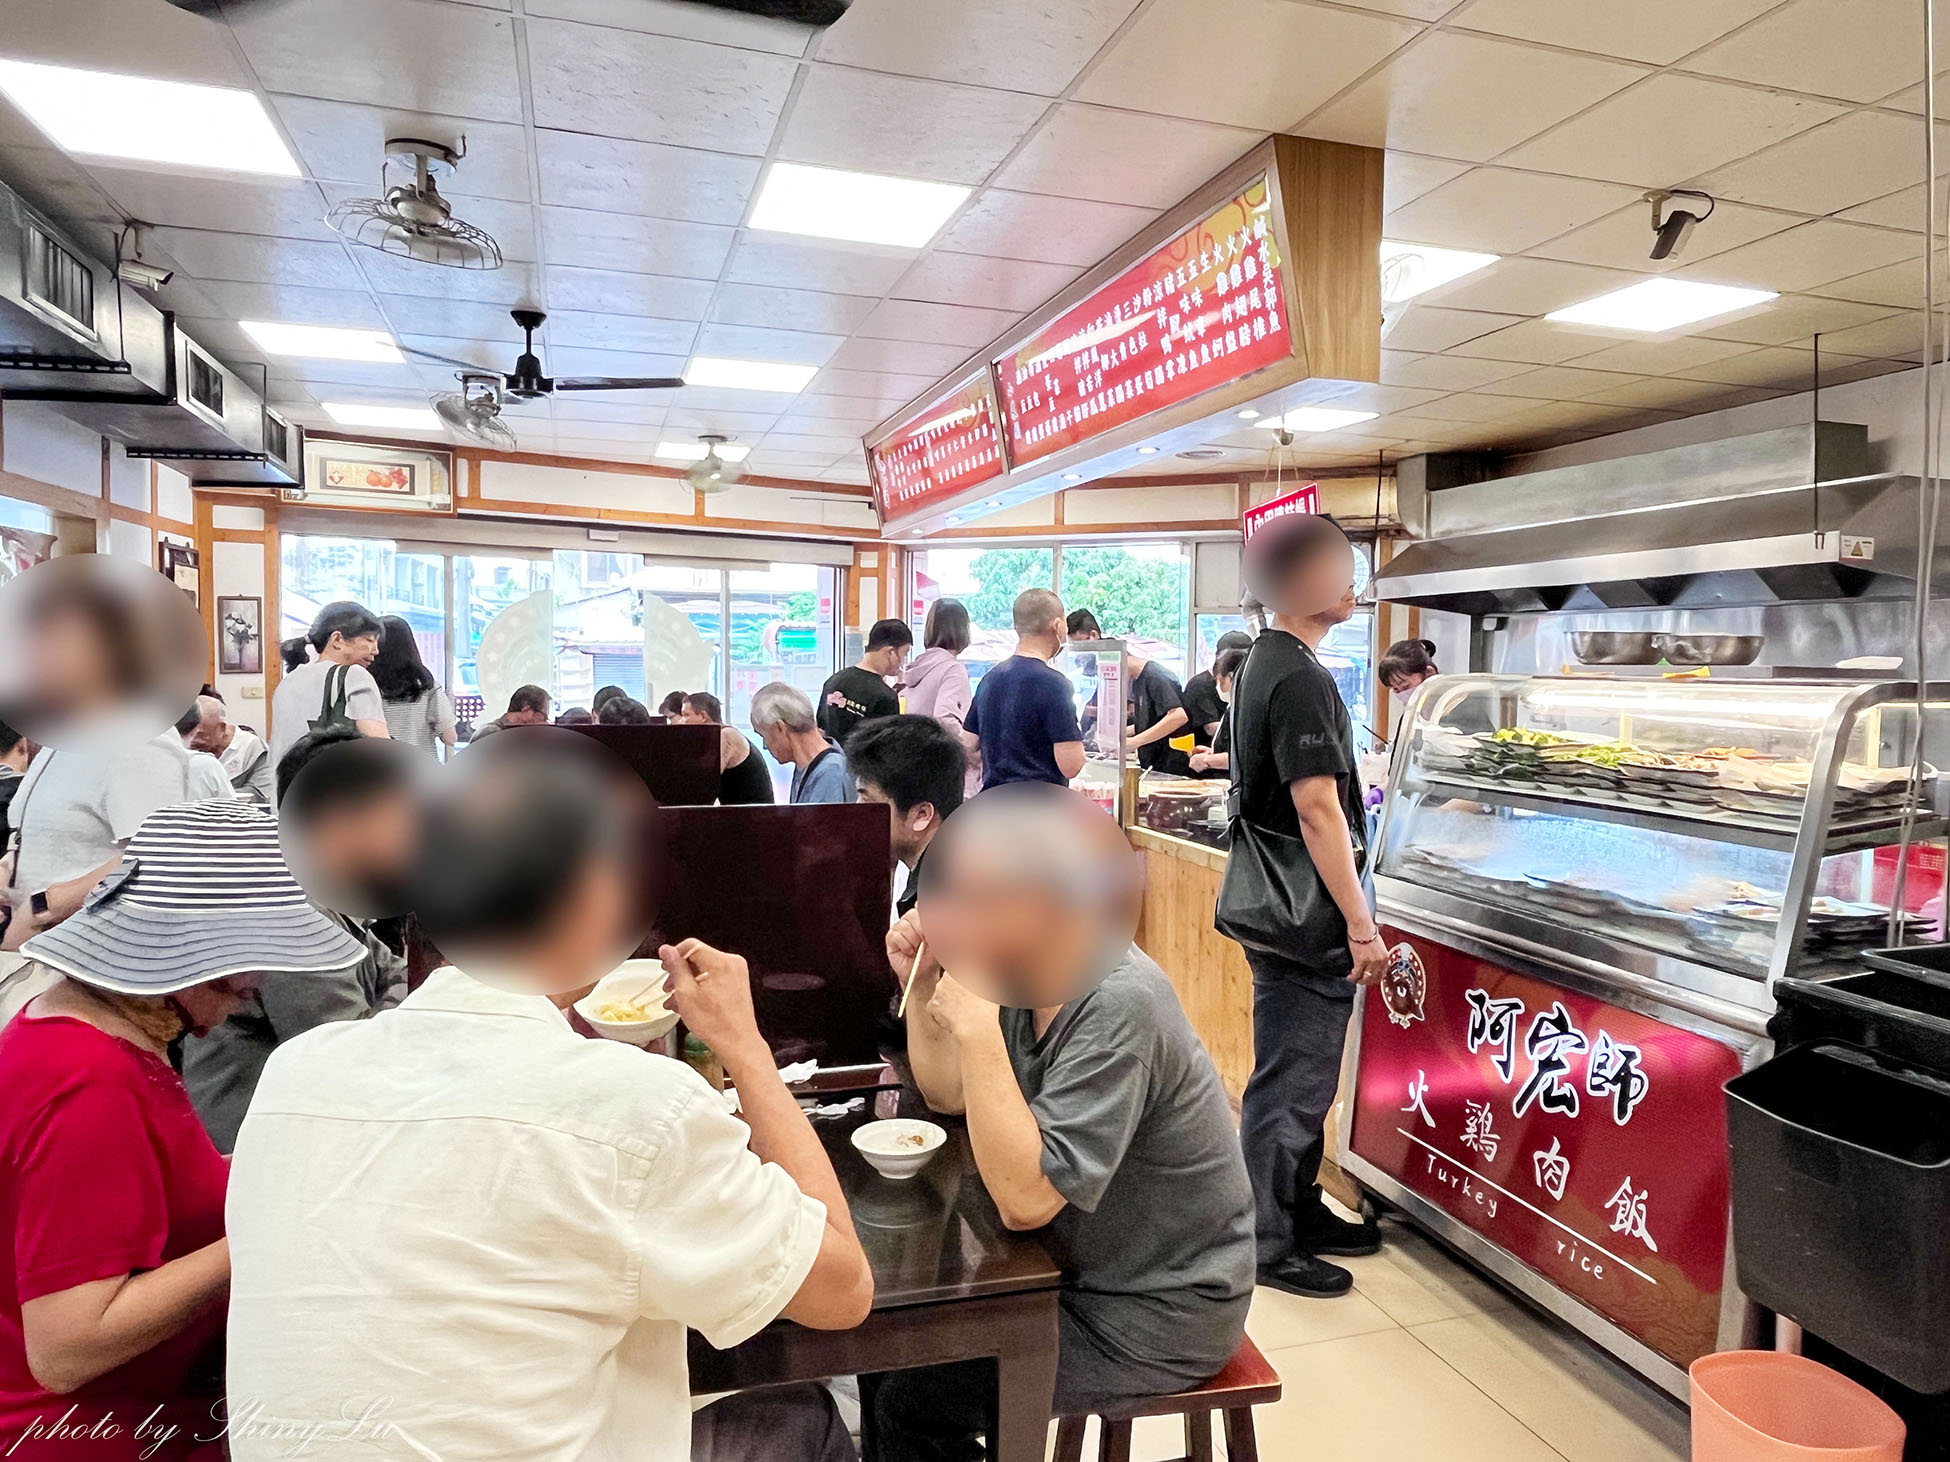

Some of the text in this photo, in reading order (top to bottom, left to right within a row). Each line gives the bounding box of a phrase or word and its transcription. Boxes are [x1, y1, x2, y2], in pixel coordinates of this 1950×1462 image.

[1465, 988, 1649, 1126] 阿宏師
[1427, 1154, 1604, 1280] Turkey rice
